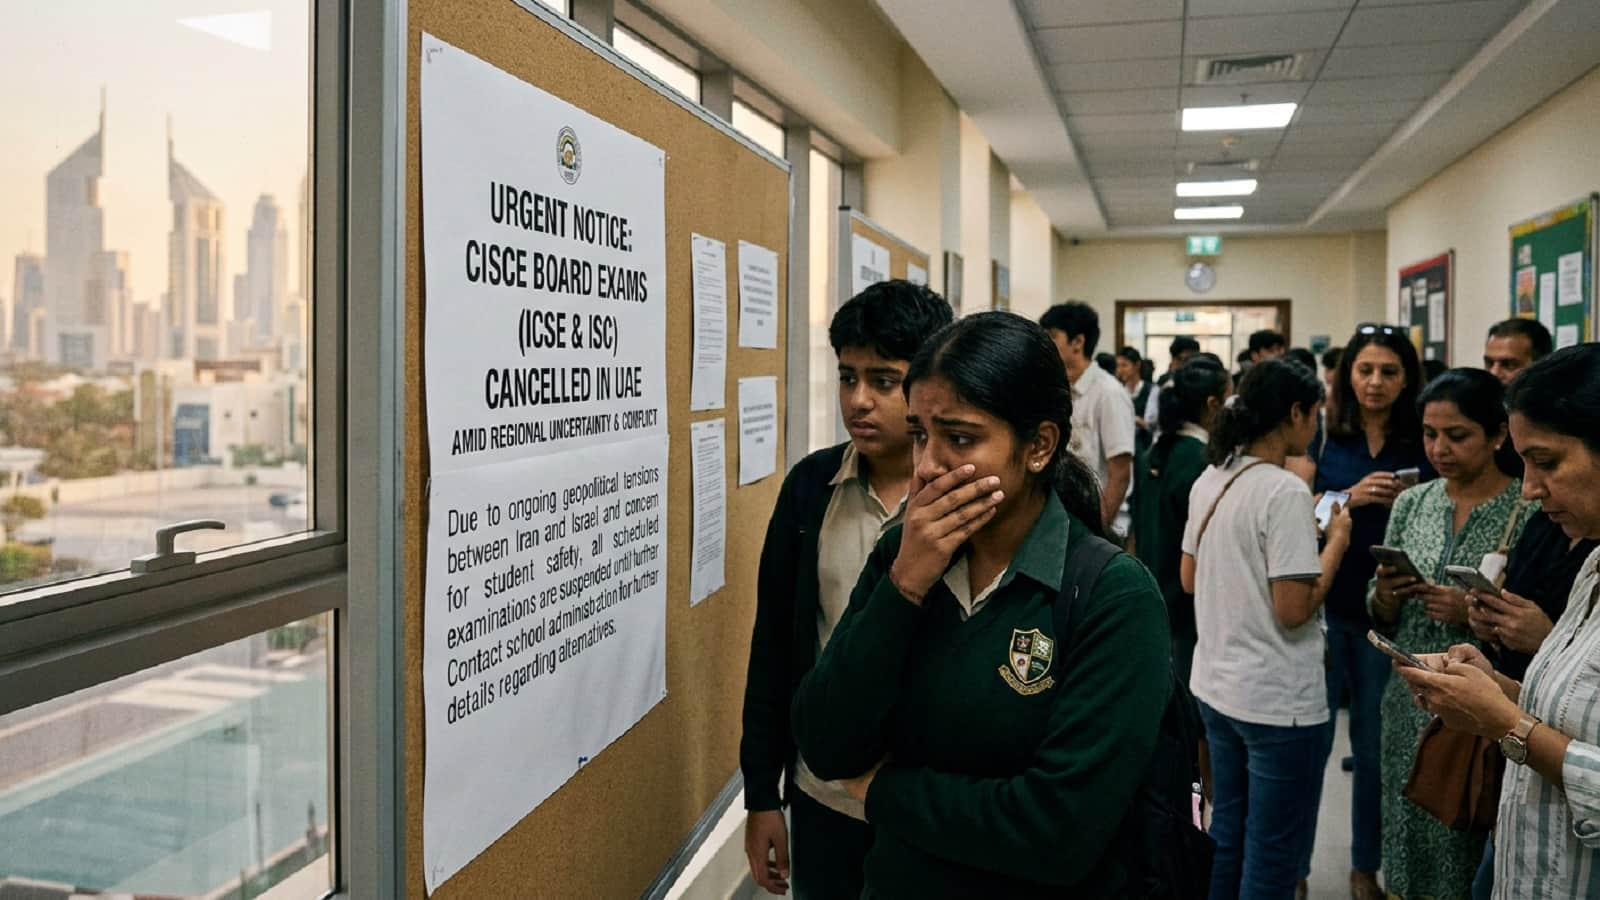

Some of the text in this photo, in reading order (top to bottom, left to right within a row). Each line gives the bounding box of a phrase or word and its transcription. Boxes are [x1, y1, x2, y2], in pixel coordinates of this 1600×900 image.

[490, 182, 632, 252] URGENT NOTICE:
[466, 240, 648, 302] CISCE BOARD EXAMS
[518, 309, 618, 357] (ICSE & ISC)
[485, 366, 642, 409] CANCELLED IN UAE
[452, 428, 487, 455] AMID
[490, 421, 547, 449] REGIONAL
[549, 413, 611, 440] UNCERTAINTY
[622, 408, 658, 430] CONFLICT
[448, 465, 659, 537] Due to ongoing geopolitical tensions
[448, 544, 508, 574] between
[516, 529, 539, 552] Iran
[544, 516, 565, 542] and
[572, 505, 599, 534] Israel
[603, 499, 620, 523] and
[447, 514, 659, 613] for student safety, all scheduled
[448, 598, 536, 649] examinations
[540, 586, 557, 609] are
[559, 558, 611, 600] suspended
[448, 639, 502, 687] Contact
[506, 618, 545, 658] school
[619, 580, 633, 601] for
[448, 618, 617, 725] details regarding alternatives.
